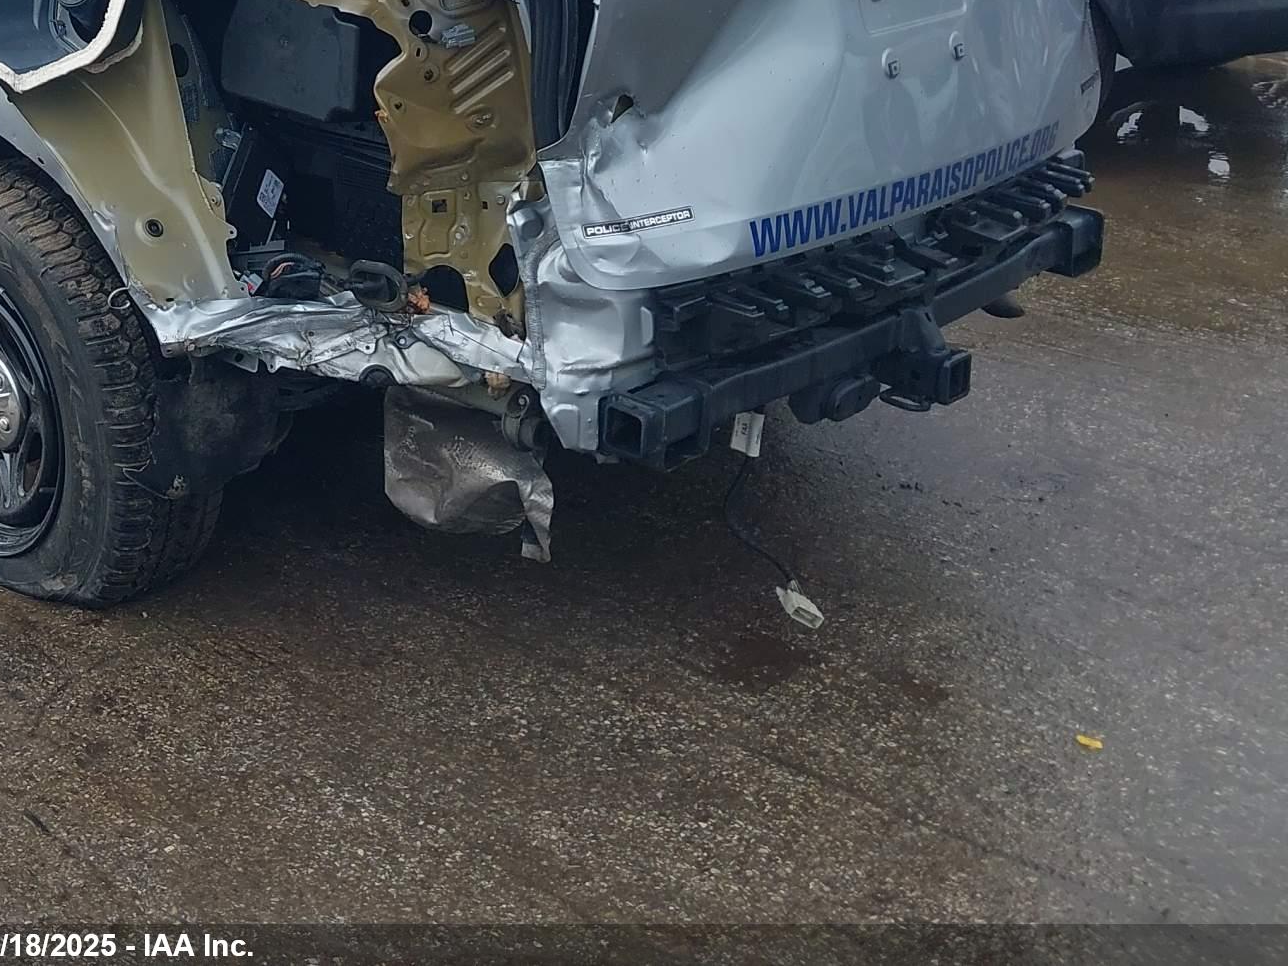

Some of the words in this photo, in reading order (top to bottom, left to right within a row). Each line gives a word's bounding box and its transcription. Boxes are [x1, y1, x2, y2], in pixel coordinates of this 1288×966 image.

[586, 222, 629, 236] POLICE
[630, 210, 691, 229] INTERCEPTOR
[749, 119, 1060, 258] WWW.VALPARAISOPOLICE.ORG
